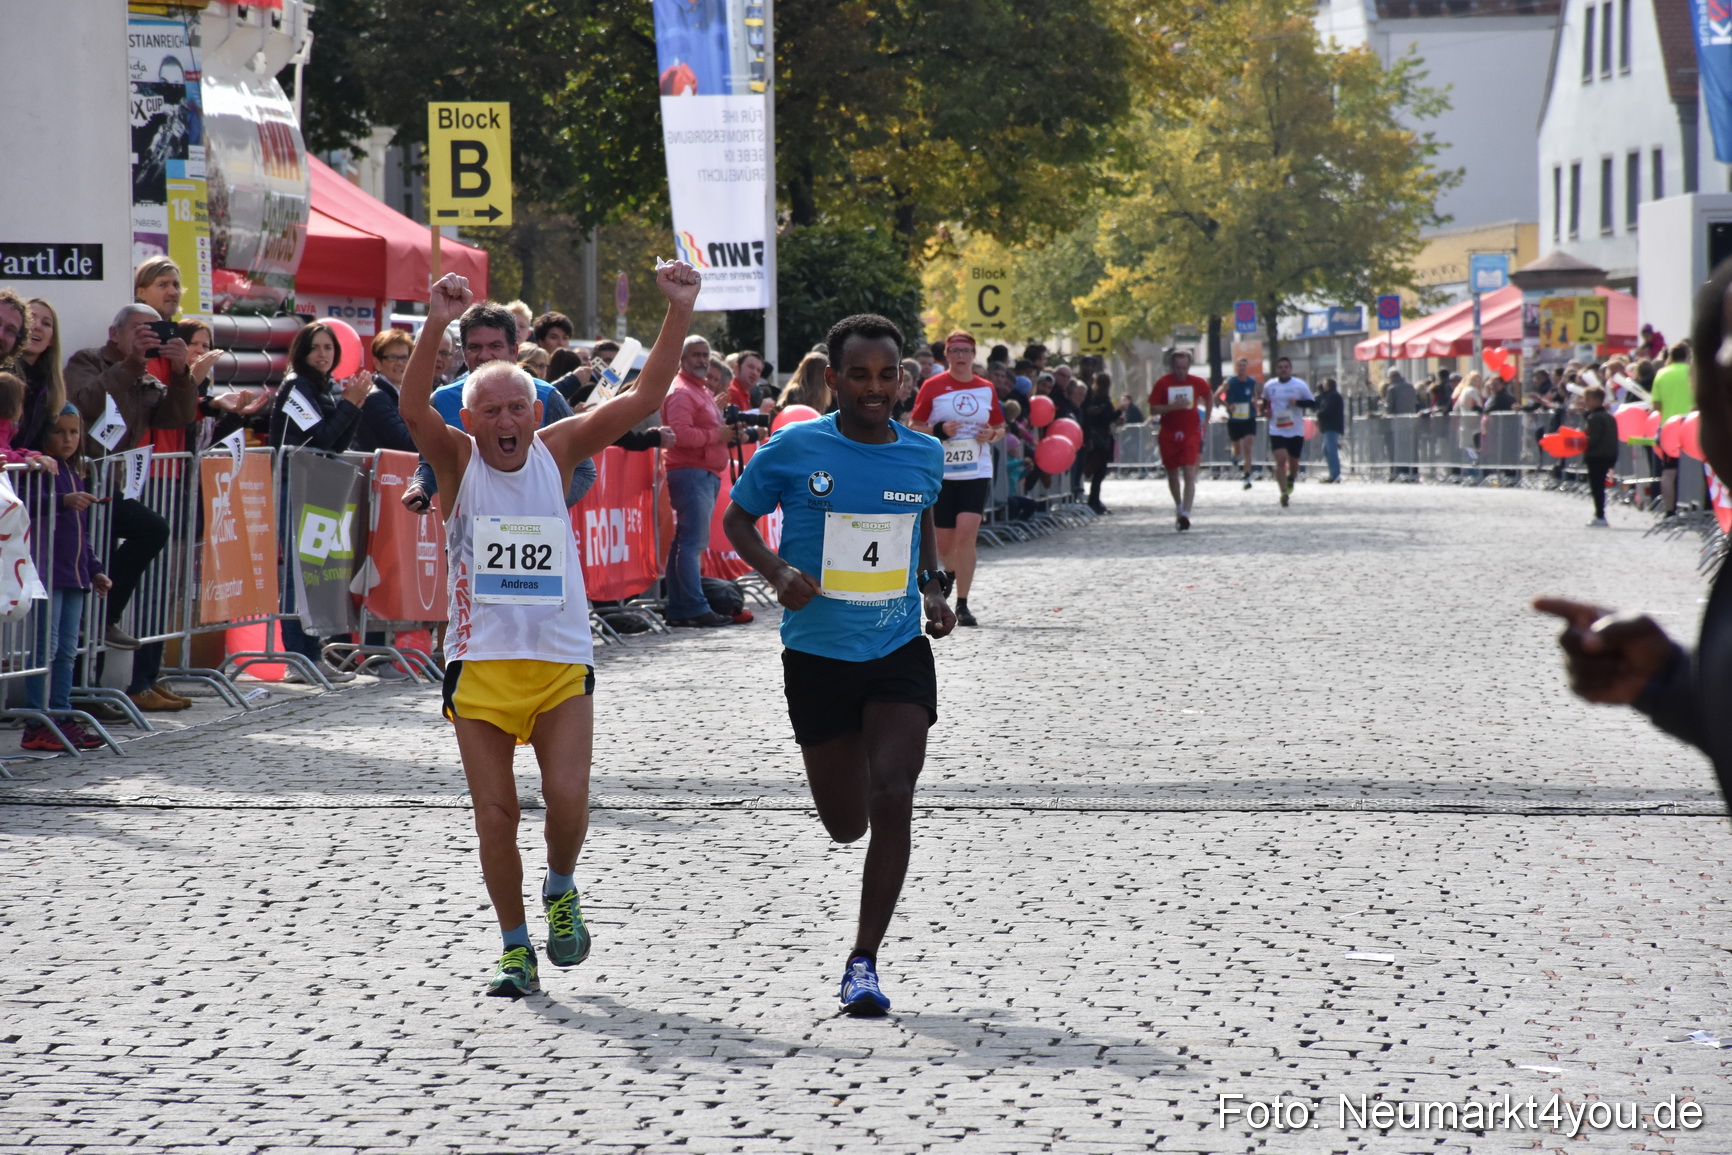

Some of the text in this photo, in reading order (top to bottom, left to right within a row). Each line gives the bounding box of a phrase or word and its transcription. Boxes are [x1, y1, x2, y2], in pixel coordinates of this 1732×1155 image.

[146, 97, 163, 112] CUP
[438, 107, 501, 129] Block
[450, 140, 491, 198] B
[171, 199, 195, 222] 18.
[0, 248, 93, 275] artl.de
[972, 267, 1007, 280] Block
[978, 284, 1001, 318] C
[1087, 321, 1104, 344] D
[1583, 311, 1600, 333] D
[945, 450, 973, 462] 2473
[883, 490, 923, 503] BOCK
[509, 524, 541, 532] BOCK
[861, 521, 891, 530] BOCK
[487, 543, 552, 570] 2182
[862, 541, 880, 567] 4
[500, 578, 539, 589] Andreas
